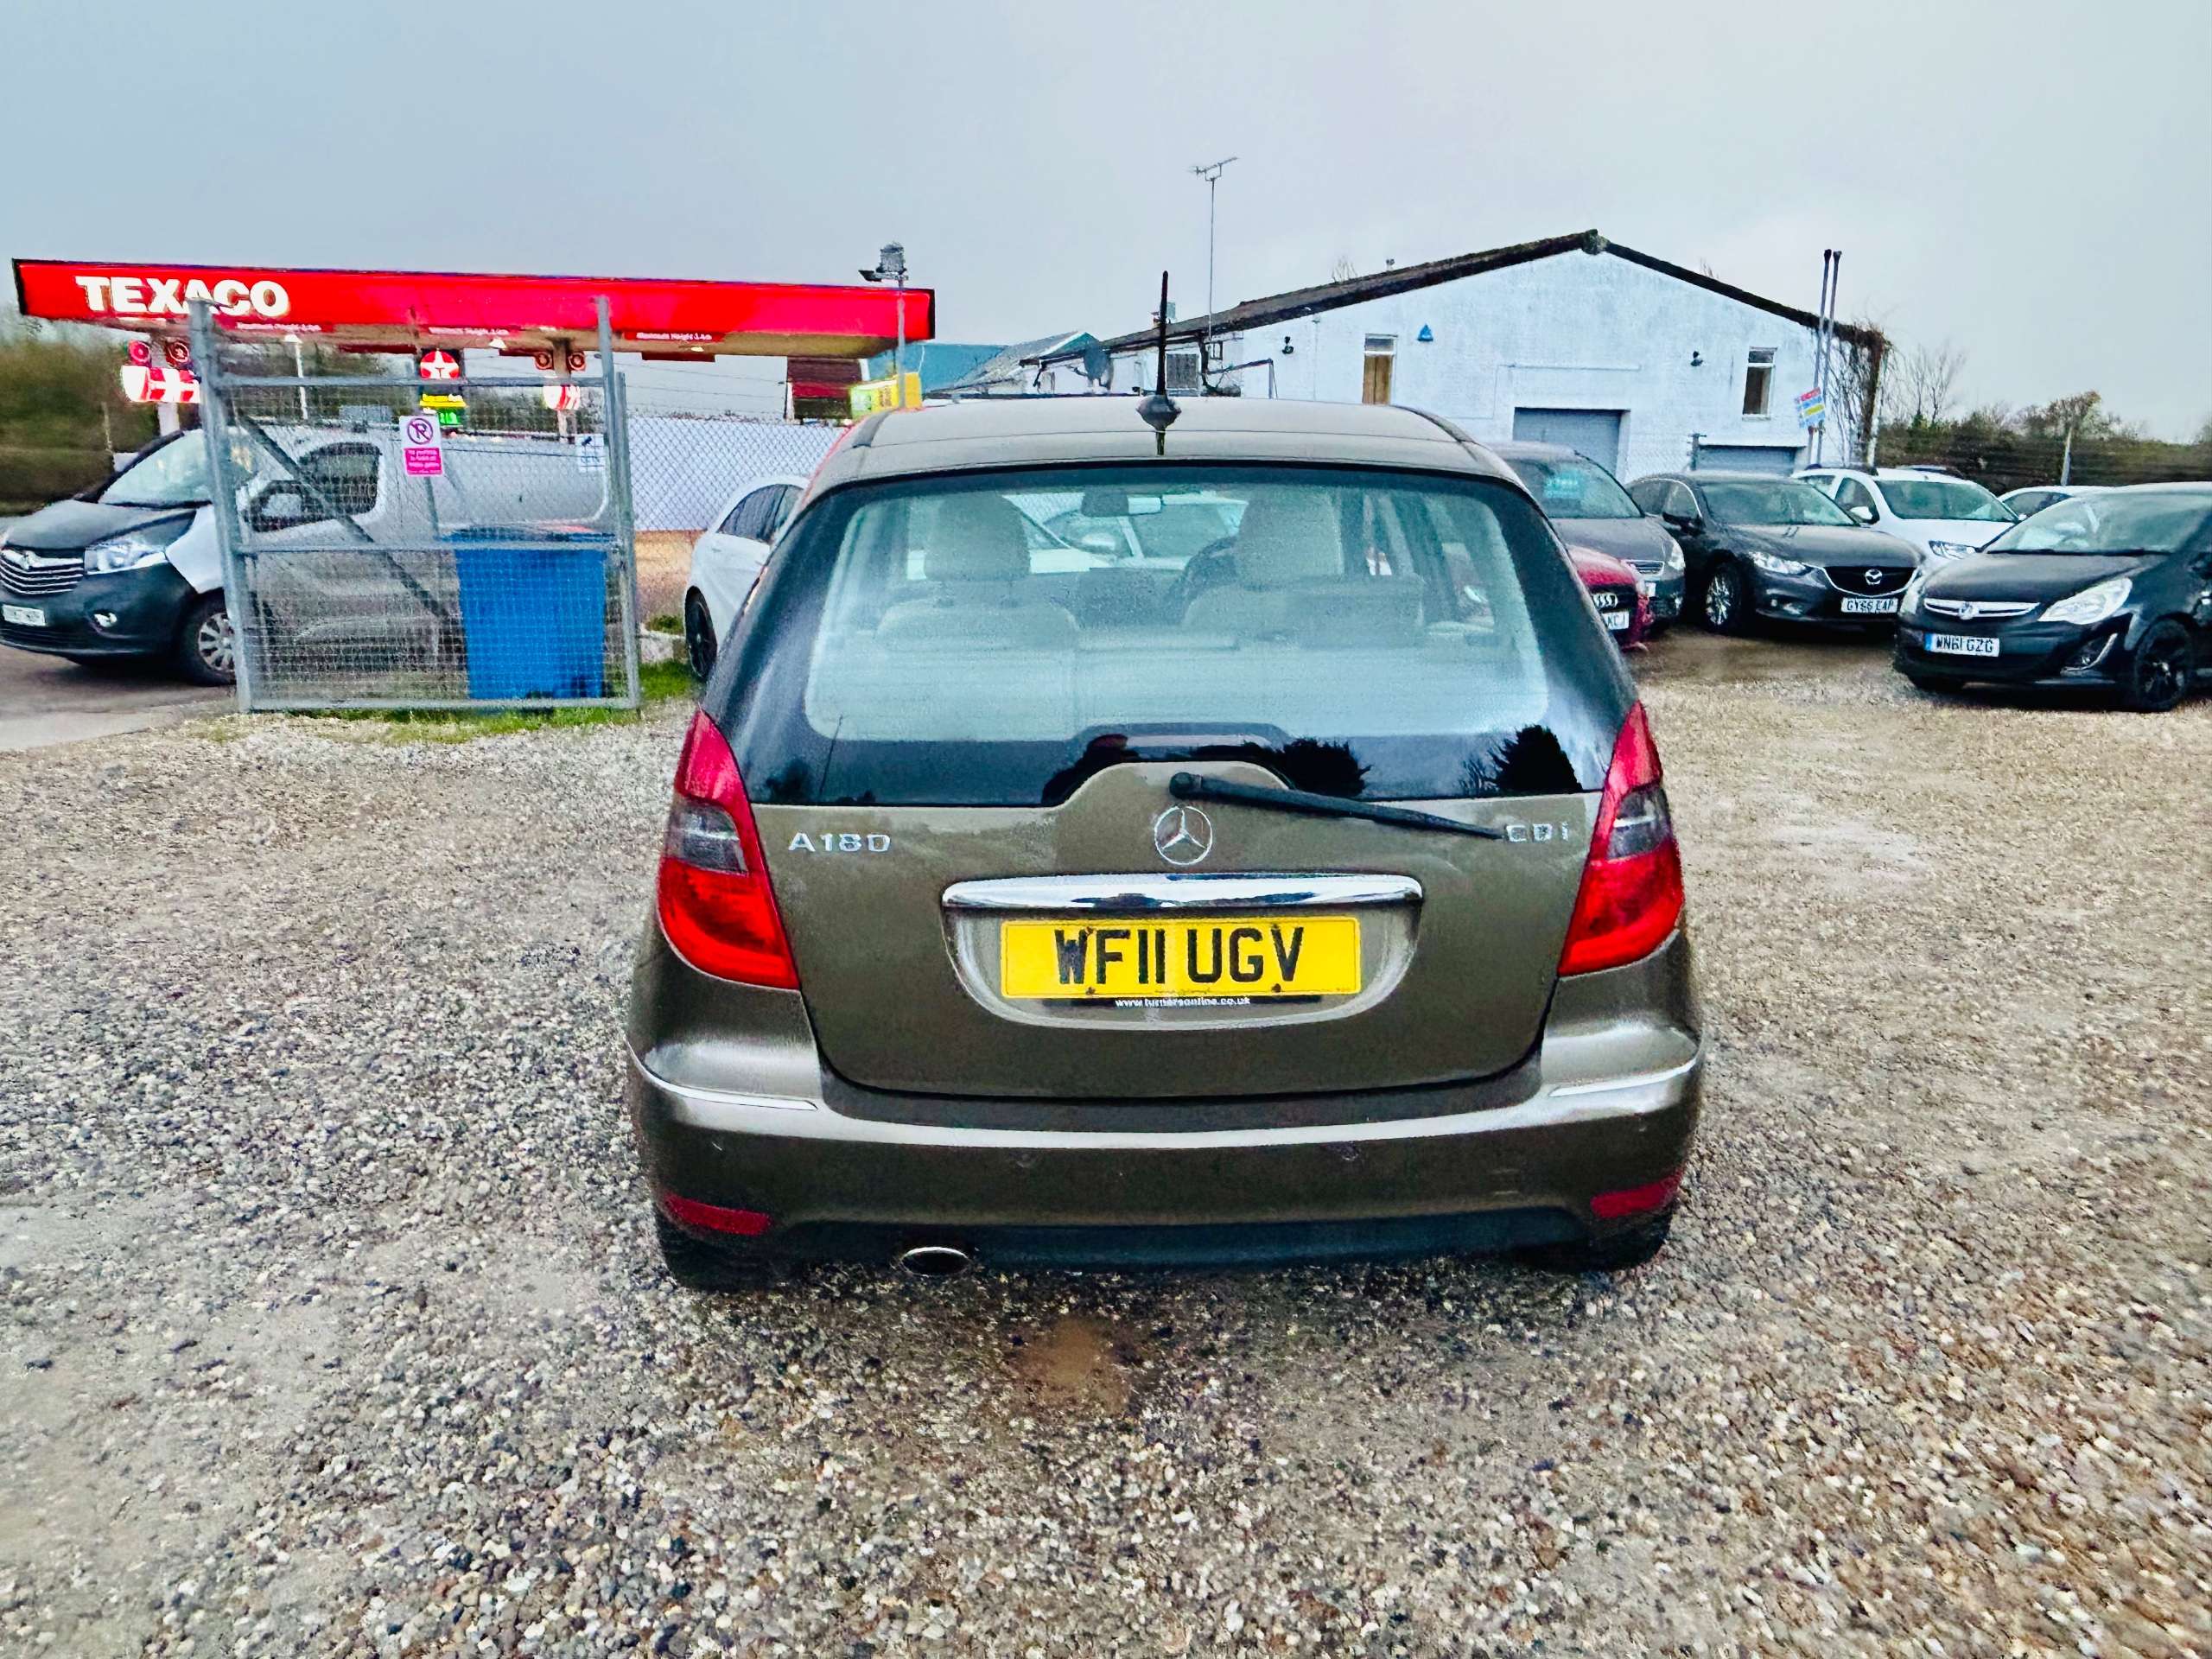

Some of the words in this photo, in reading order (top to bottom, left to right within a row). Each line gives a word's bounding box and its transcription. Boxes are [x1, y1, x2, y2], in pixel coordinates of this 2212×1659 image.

[75, 276, 292, 317] TEXACO
[788, 832, 891, 852] A180
[1054, 928, 1167, 985] WF11
[1187, 926, 1305, 984] UGV
